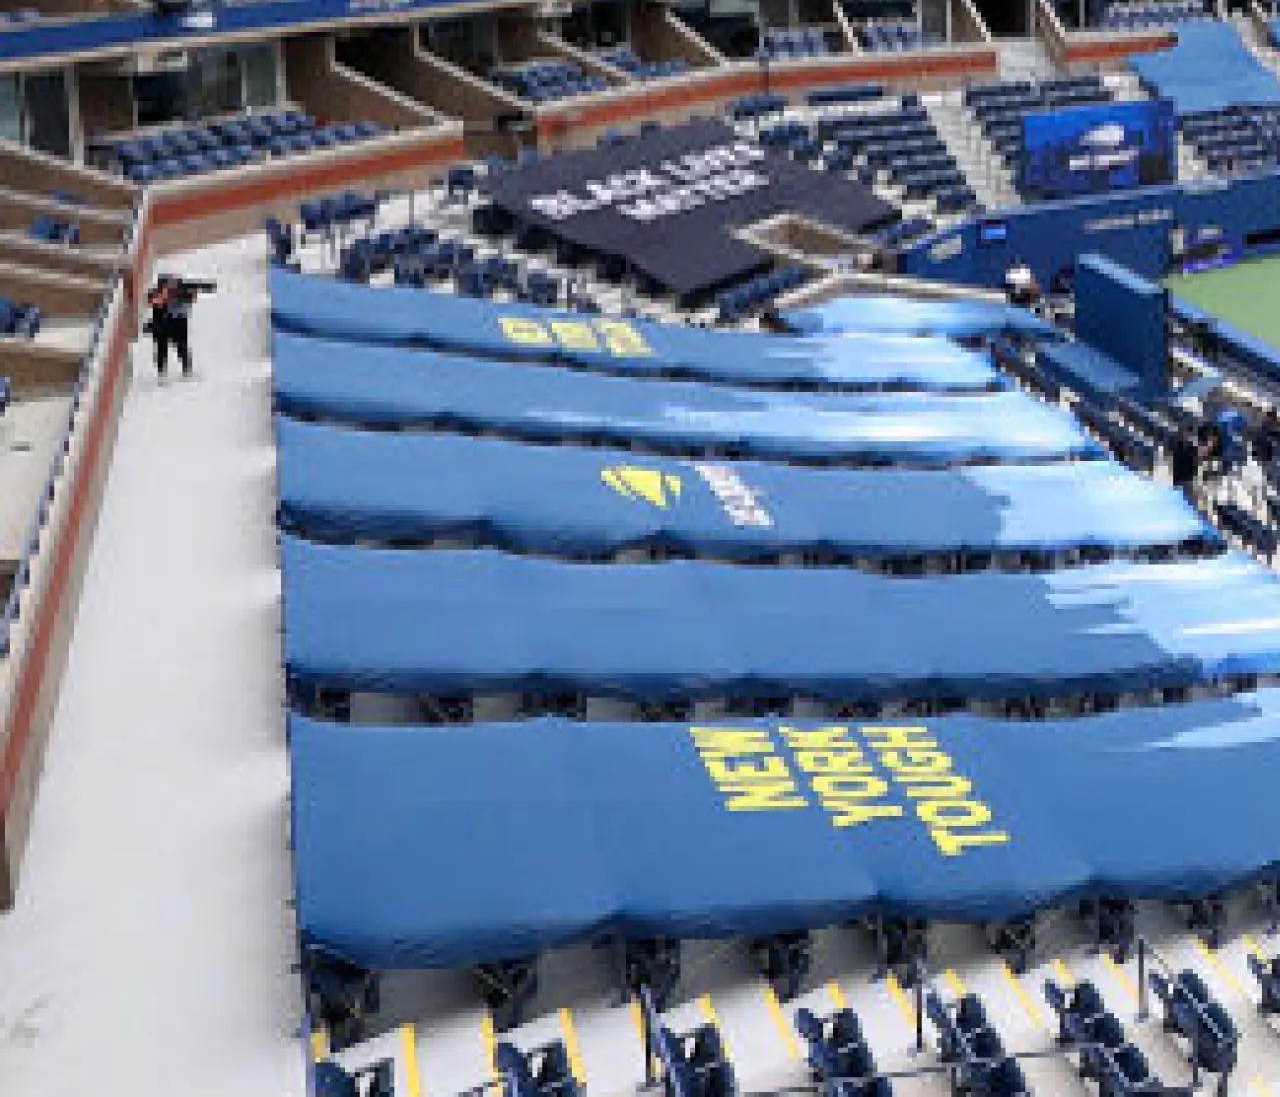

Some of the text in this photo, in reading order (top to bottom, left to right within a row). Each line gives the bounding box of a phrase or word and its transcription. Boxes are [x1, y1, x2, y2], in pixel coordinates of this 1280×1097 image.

[528, 166, 666, 221] BLACK
[688, 725, 809, 813] NEW
[777, 725, 904, 830] YORK
[858, 725, 1012, 857] TOUGH
